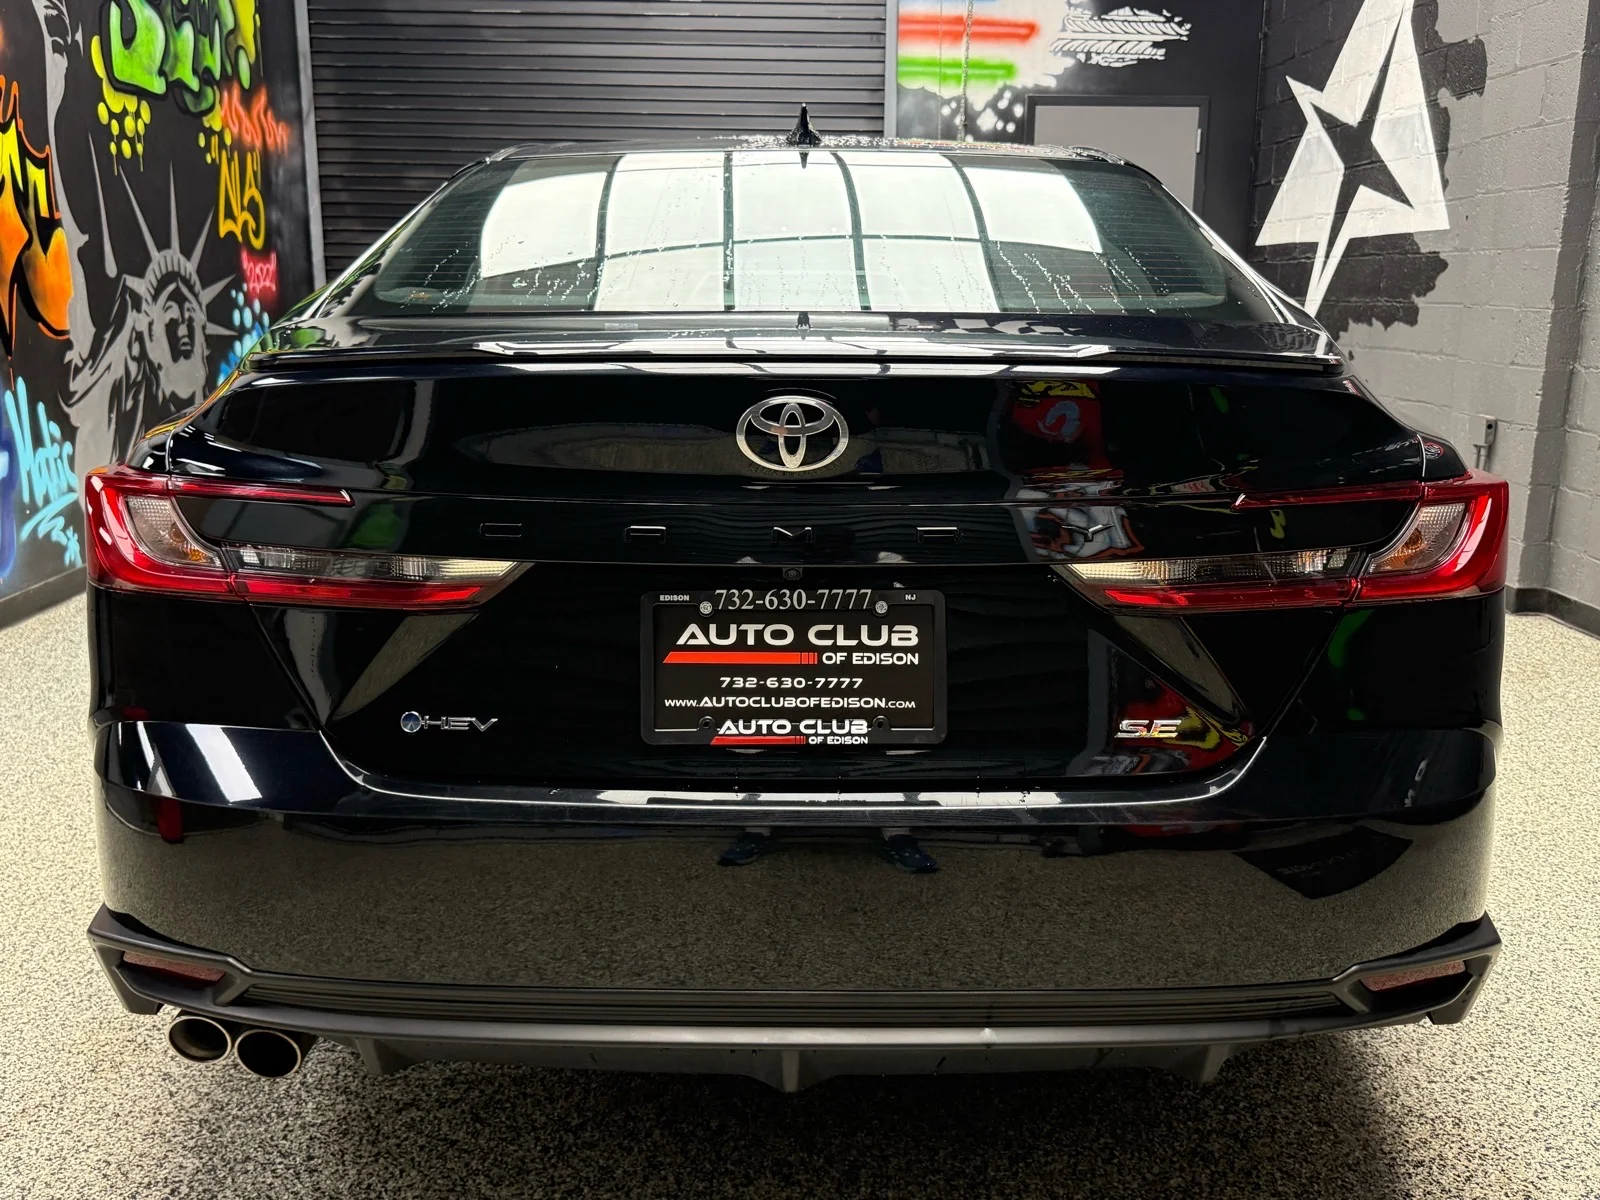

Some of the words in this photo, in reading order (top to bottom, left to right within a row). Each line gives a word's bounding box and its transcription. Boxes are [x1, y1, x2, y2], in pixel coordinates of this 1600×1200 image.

[715, 589, 872, 610] 732-630-7777
[676, 624, 794, 646] AUTO
[808, 624, 918, 646] CLUB
[822, 653, 847, 664] OF
[852, 653, 919, 665] EDISON
[719, 677, 863, 689] 732-630-7777
[718, 719, 791, 734] AUTO
[800, 719, 868, 734] CLUB
[1114, 719, 1182, 738] SE
[808, 736, 824, 744] OF
[827, 736, 868, 744] EDISON
